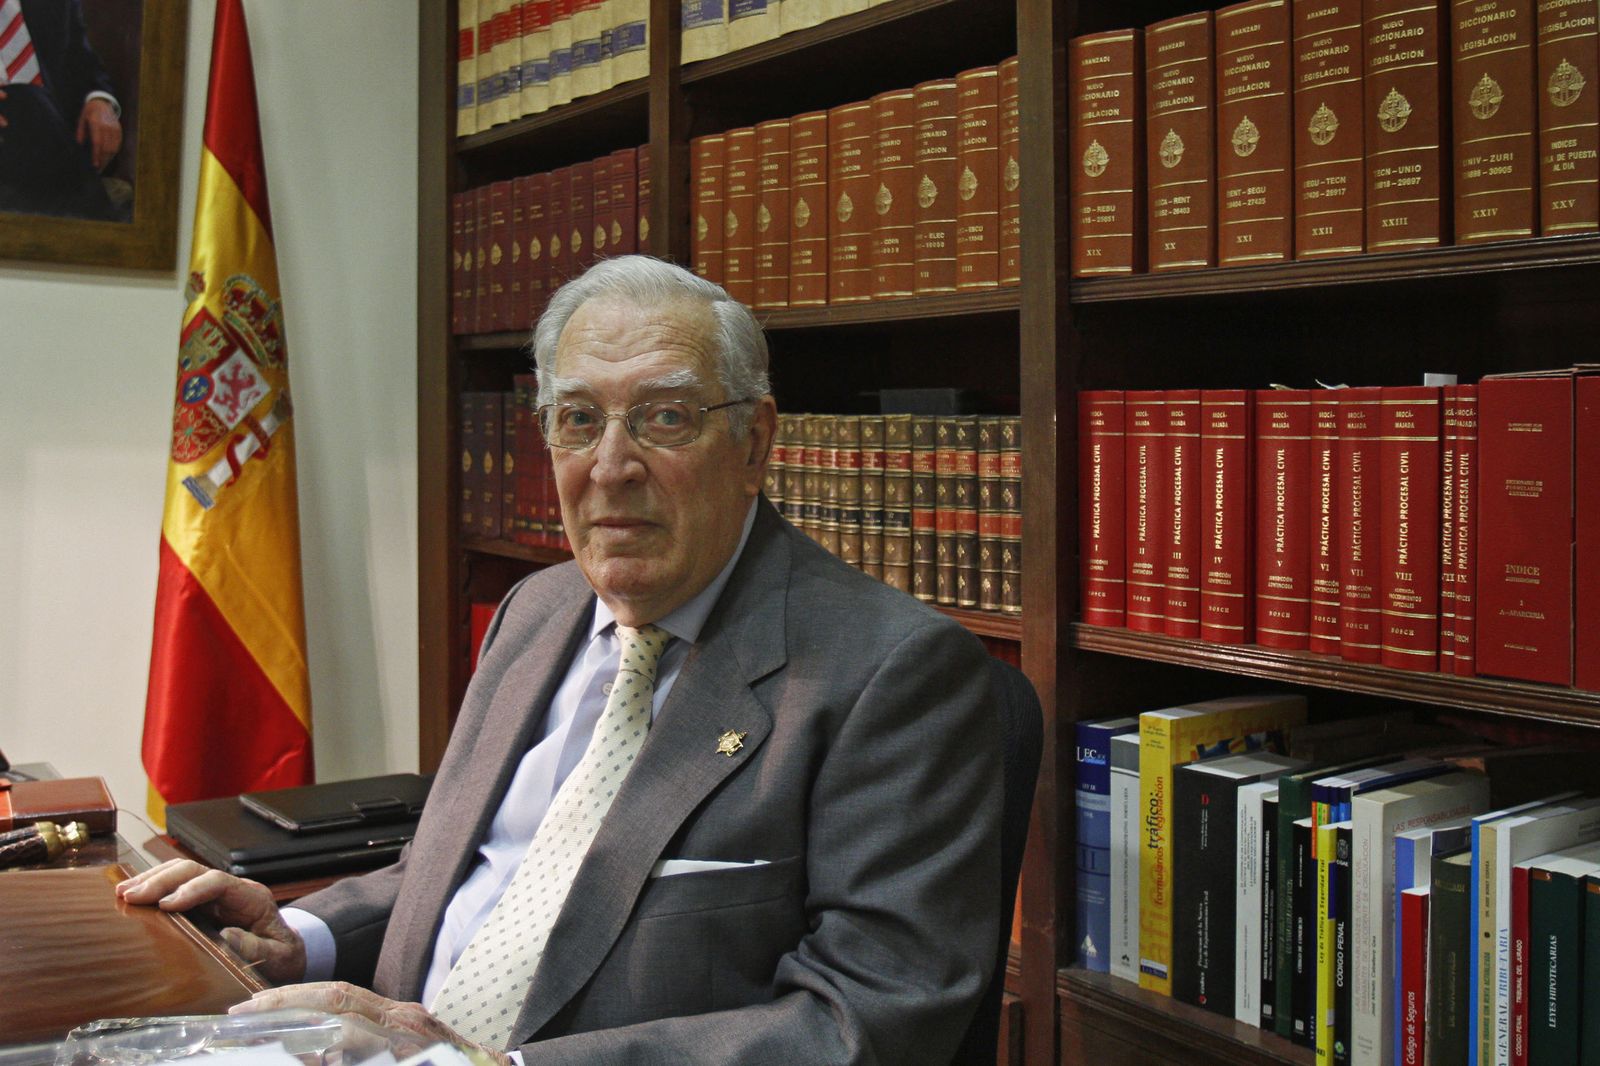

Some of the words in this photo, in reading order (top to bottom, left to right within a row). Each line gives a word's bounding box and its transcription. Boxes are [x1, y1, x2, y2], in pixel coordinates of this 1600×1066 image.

[1306, 6, 1339, 21] ARANZADI
[1474, 2, 1498, 14] NUEVO
[1382, 19, 1405, 31] NUEVO
[1459, 9, 1517, 30] DICCIONARIO
[1540, 16, 1596, 35] EGISLACION
[1230, 24, 1261, 37] ARANZADI
[1460, 32, 1517, 52] LEGISLACION
[1082, 56, 1111, 66] RANZADI
[1551, 138, 1578, 150] INDICES
[1568, 150, 1598, 160] PUESTA
[1472, 208, 1499, 219] XXIV
[1552, 198, 1577, 210] XXV
[1312, 226, 1334, 236] XXII
[1381, 217, 1408, 228] XXIII
[1164, 242, 1176, 251] XX
[1236, 234, 1252, 244] XXI
[1458, 409, 1476, 417] ROCÁ-
[1093, 444, 1101, 463] CIVIL
[1139, 445, 1147, 464] CIVIL
[1174, 445, 1182, 465] CIVIL
[1216, 448, 1224, 468] CIVIL
[1277, 448, 1285, 470] CIVIL
[1322, 450, 1330, 471] CIVIL
[1353, 451, 1361, 472] CIVIL
[1400, 451, 1409, 474] CIVIL
[1444, 450, 1453, 472] CIVIL
[1459, 453, 1469, 476] CIVIL
[1093, 464, 1101, 501] PROCESAL
[1139, 466, 1147, 504] PROCESAL
[1174, 467, 1182, 506] PROCESAL
[1216, 470, 1224, 509] PROCESAL
[1277, 472, 1285, 512] PROCESAL
[1322, 472, 1330, 514] PROCESAL
[1353, 474, 1362, 518] PROCESAL
[1400, 476, 1409, 520] PROCESAL
[1443, 474, 1453, 519] PROCESAL
[1459, 478, 1469, 523] PROCESAL
[1092, 502, 1100, 538] PRÁCTICA
[1138, 505, 1146, 542] PRÁCTICA
[1173, 507, 1182, 544] PRÁCTICA
[1214, 511, 1224, 550] PRÁCTICA
[1275, 514, 1285, 552] PRÁCTICA
[1320, 516, 1330, 556] PRÁCTICA
[1351, 520, 1362, 561] PRÁCTICA
[1398, 522, 1408, 565] PRÁCTICA
[1139, 547, 1145, 555] II
[1173, 552, 1182, 560] III
[1458, 526, 1468, 570] PRÁCTICA
[1214, 556, 1223, 564] IV
[1276, 560, 1284, 568] V
[1320, 563, 1330, 572] VI
[1505, 564, 1540, 576] INDICE
[1350, 568, 1364, 576] VII
[1395, 572, 1412, 581] VIII
[1457, 574, 1468, 583] IX
[1455, 634, 1470, 643] OSCH
[1155, 776, 1166, 832] legislación
[1154, 846, 1164, 905] formularios
[1336, 921, 1344, 950] PENAL
[1336, 952, 1344, 987] CÓDIGO
[1549, 935, 1558, 1000] HIPOTECARIAS
[1406, 991, 1418, 1023] Seguros
[1548, 1002, 1557, 1028] LEYES
[1406, 1024, 1415, 1035] de
[1498, 1002, 1508, 1057] GENERAL
[1406, 1036, 1418, 1064] Código
